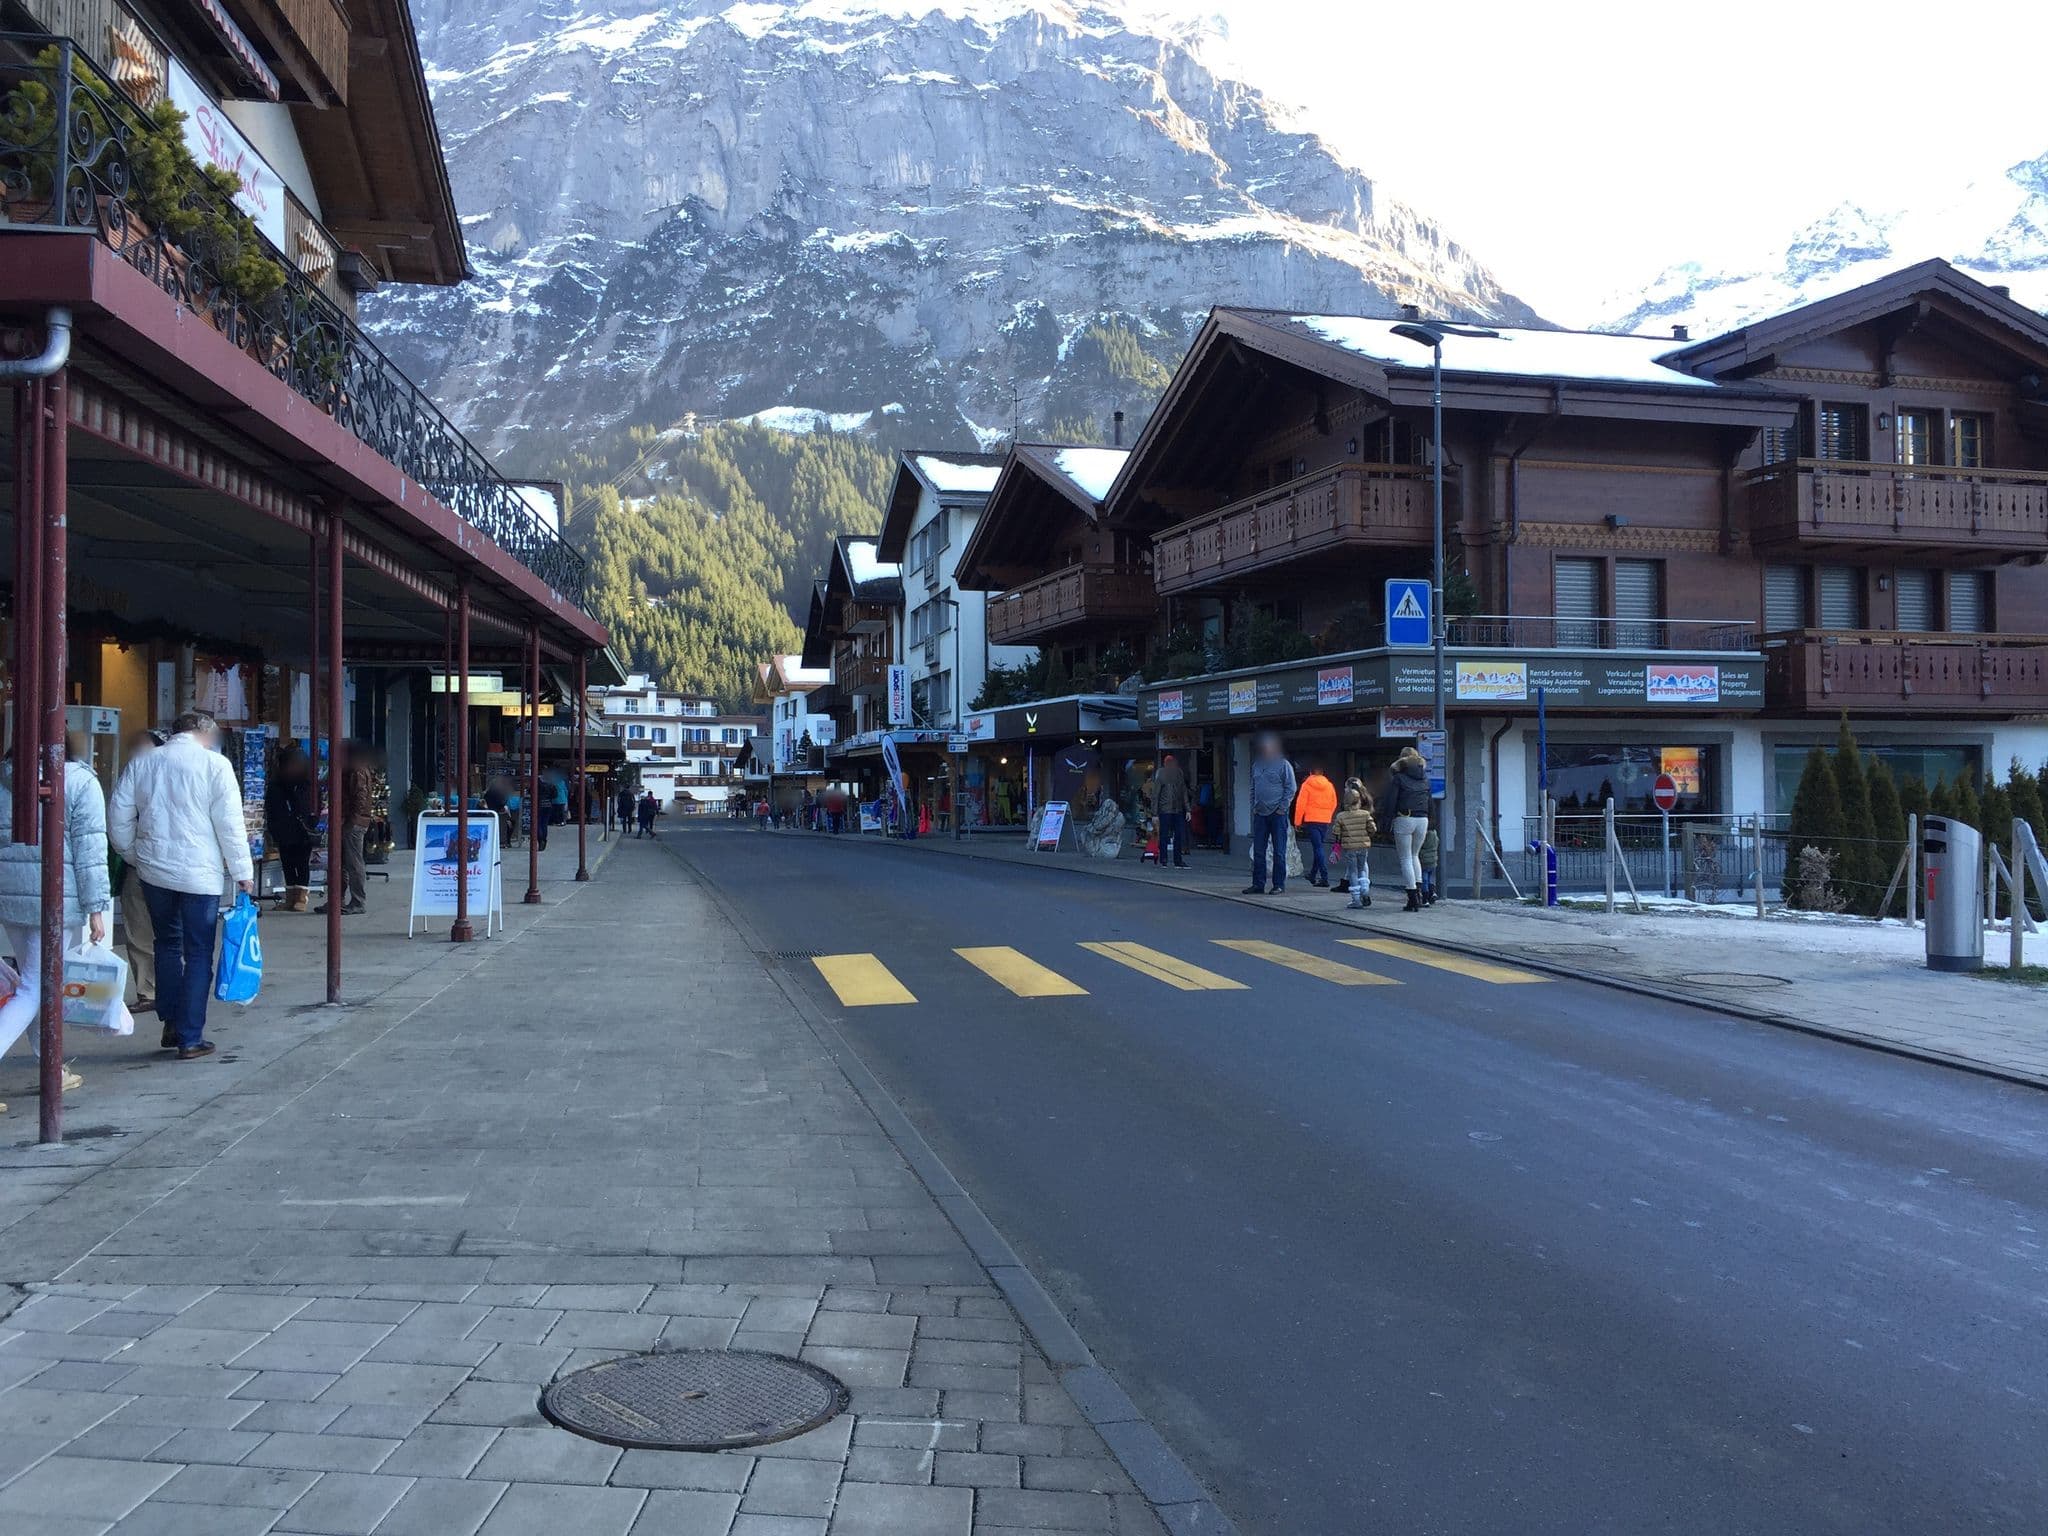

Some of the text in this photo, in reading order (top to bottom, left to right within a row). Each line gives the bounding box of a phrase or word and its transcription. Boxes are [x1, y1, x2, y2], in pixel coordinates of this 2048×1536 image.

[196, 105, 268, 213] Skisule
[1402, 668, 1436, 676] Vermietun
[1606, 670, 1631, 678] Verkauf
[1395, 677, 1453, 686] Ferienwohnen
[1529, 679, 1591, 688] Holiday Apartments
[1608, 679, 1644, 688] Verwaltung
[1721, 680, 1748, 689] Property
[427, 863, 483, 877] Skisule
